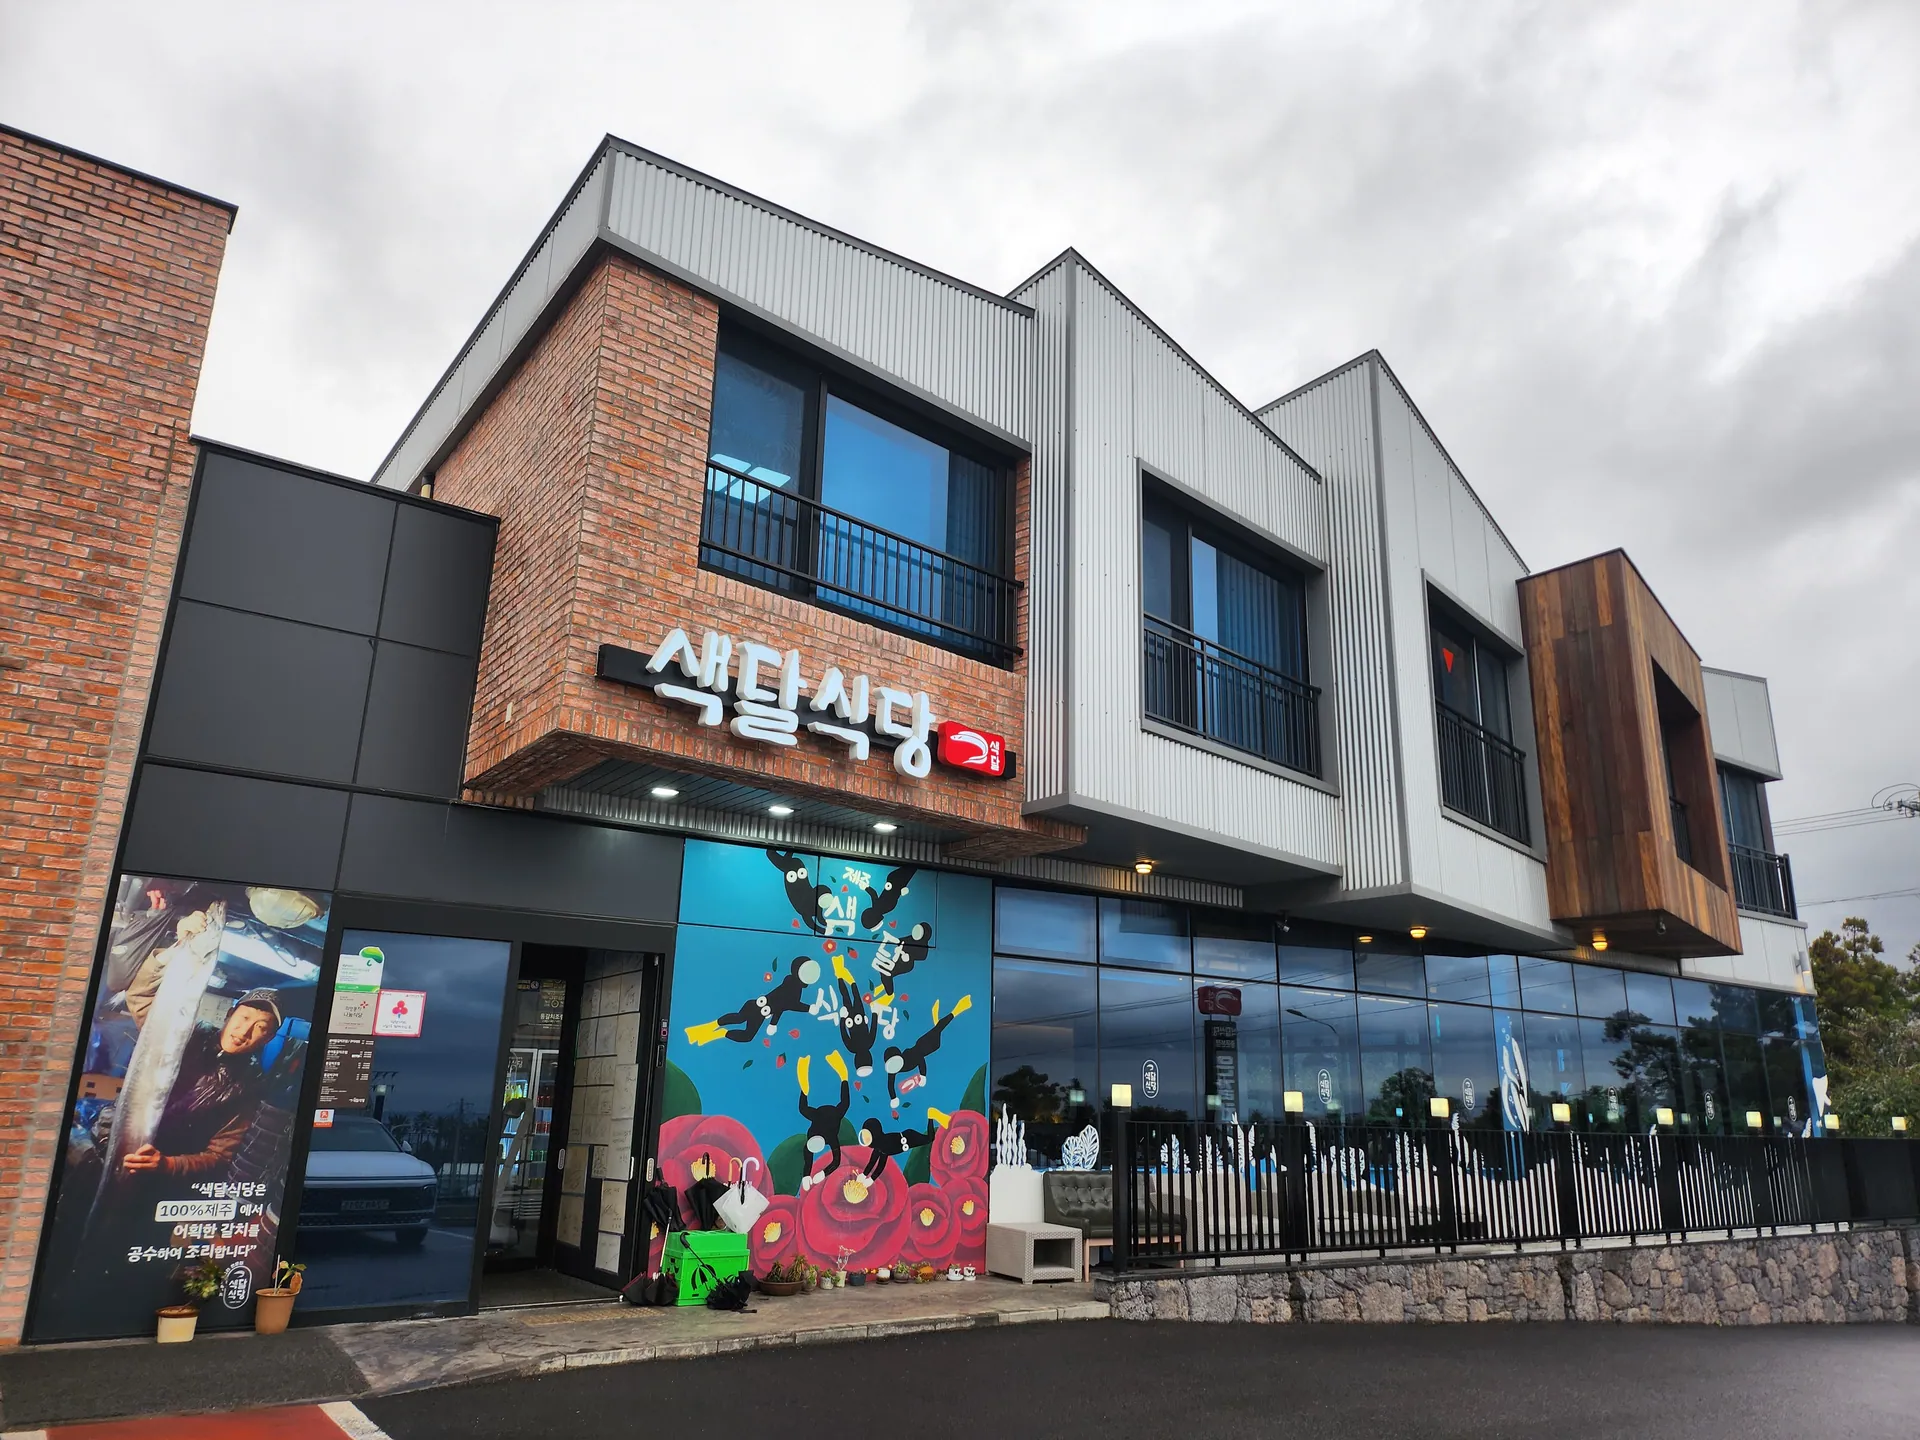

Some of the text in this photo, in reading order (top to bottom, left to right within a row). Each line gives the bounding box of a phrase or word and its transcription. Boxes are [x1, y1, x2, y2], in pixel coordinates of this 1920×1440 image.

[645, 628, 935, 779] 색달식당
[191, 1181, 266, 1198] “색달식당은
[160, 1203, 263, 1217] 100%제주 에서
[173, 1222, 260, 1239] 어획한 갈치를
[127, 1243, 257, 1262] 공수하여 조리합니다”
[228, 1289, 246, 1300] 식당
